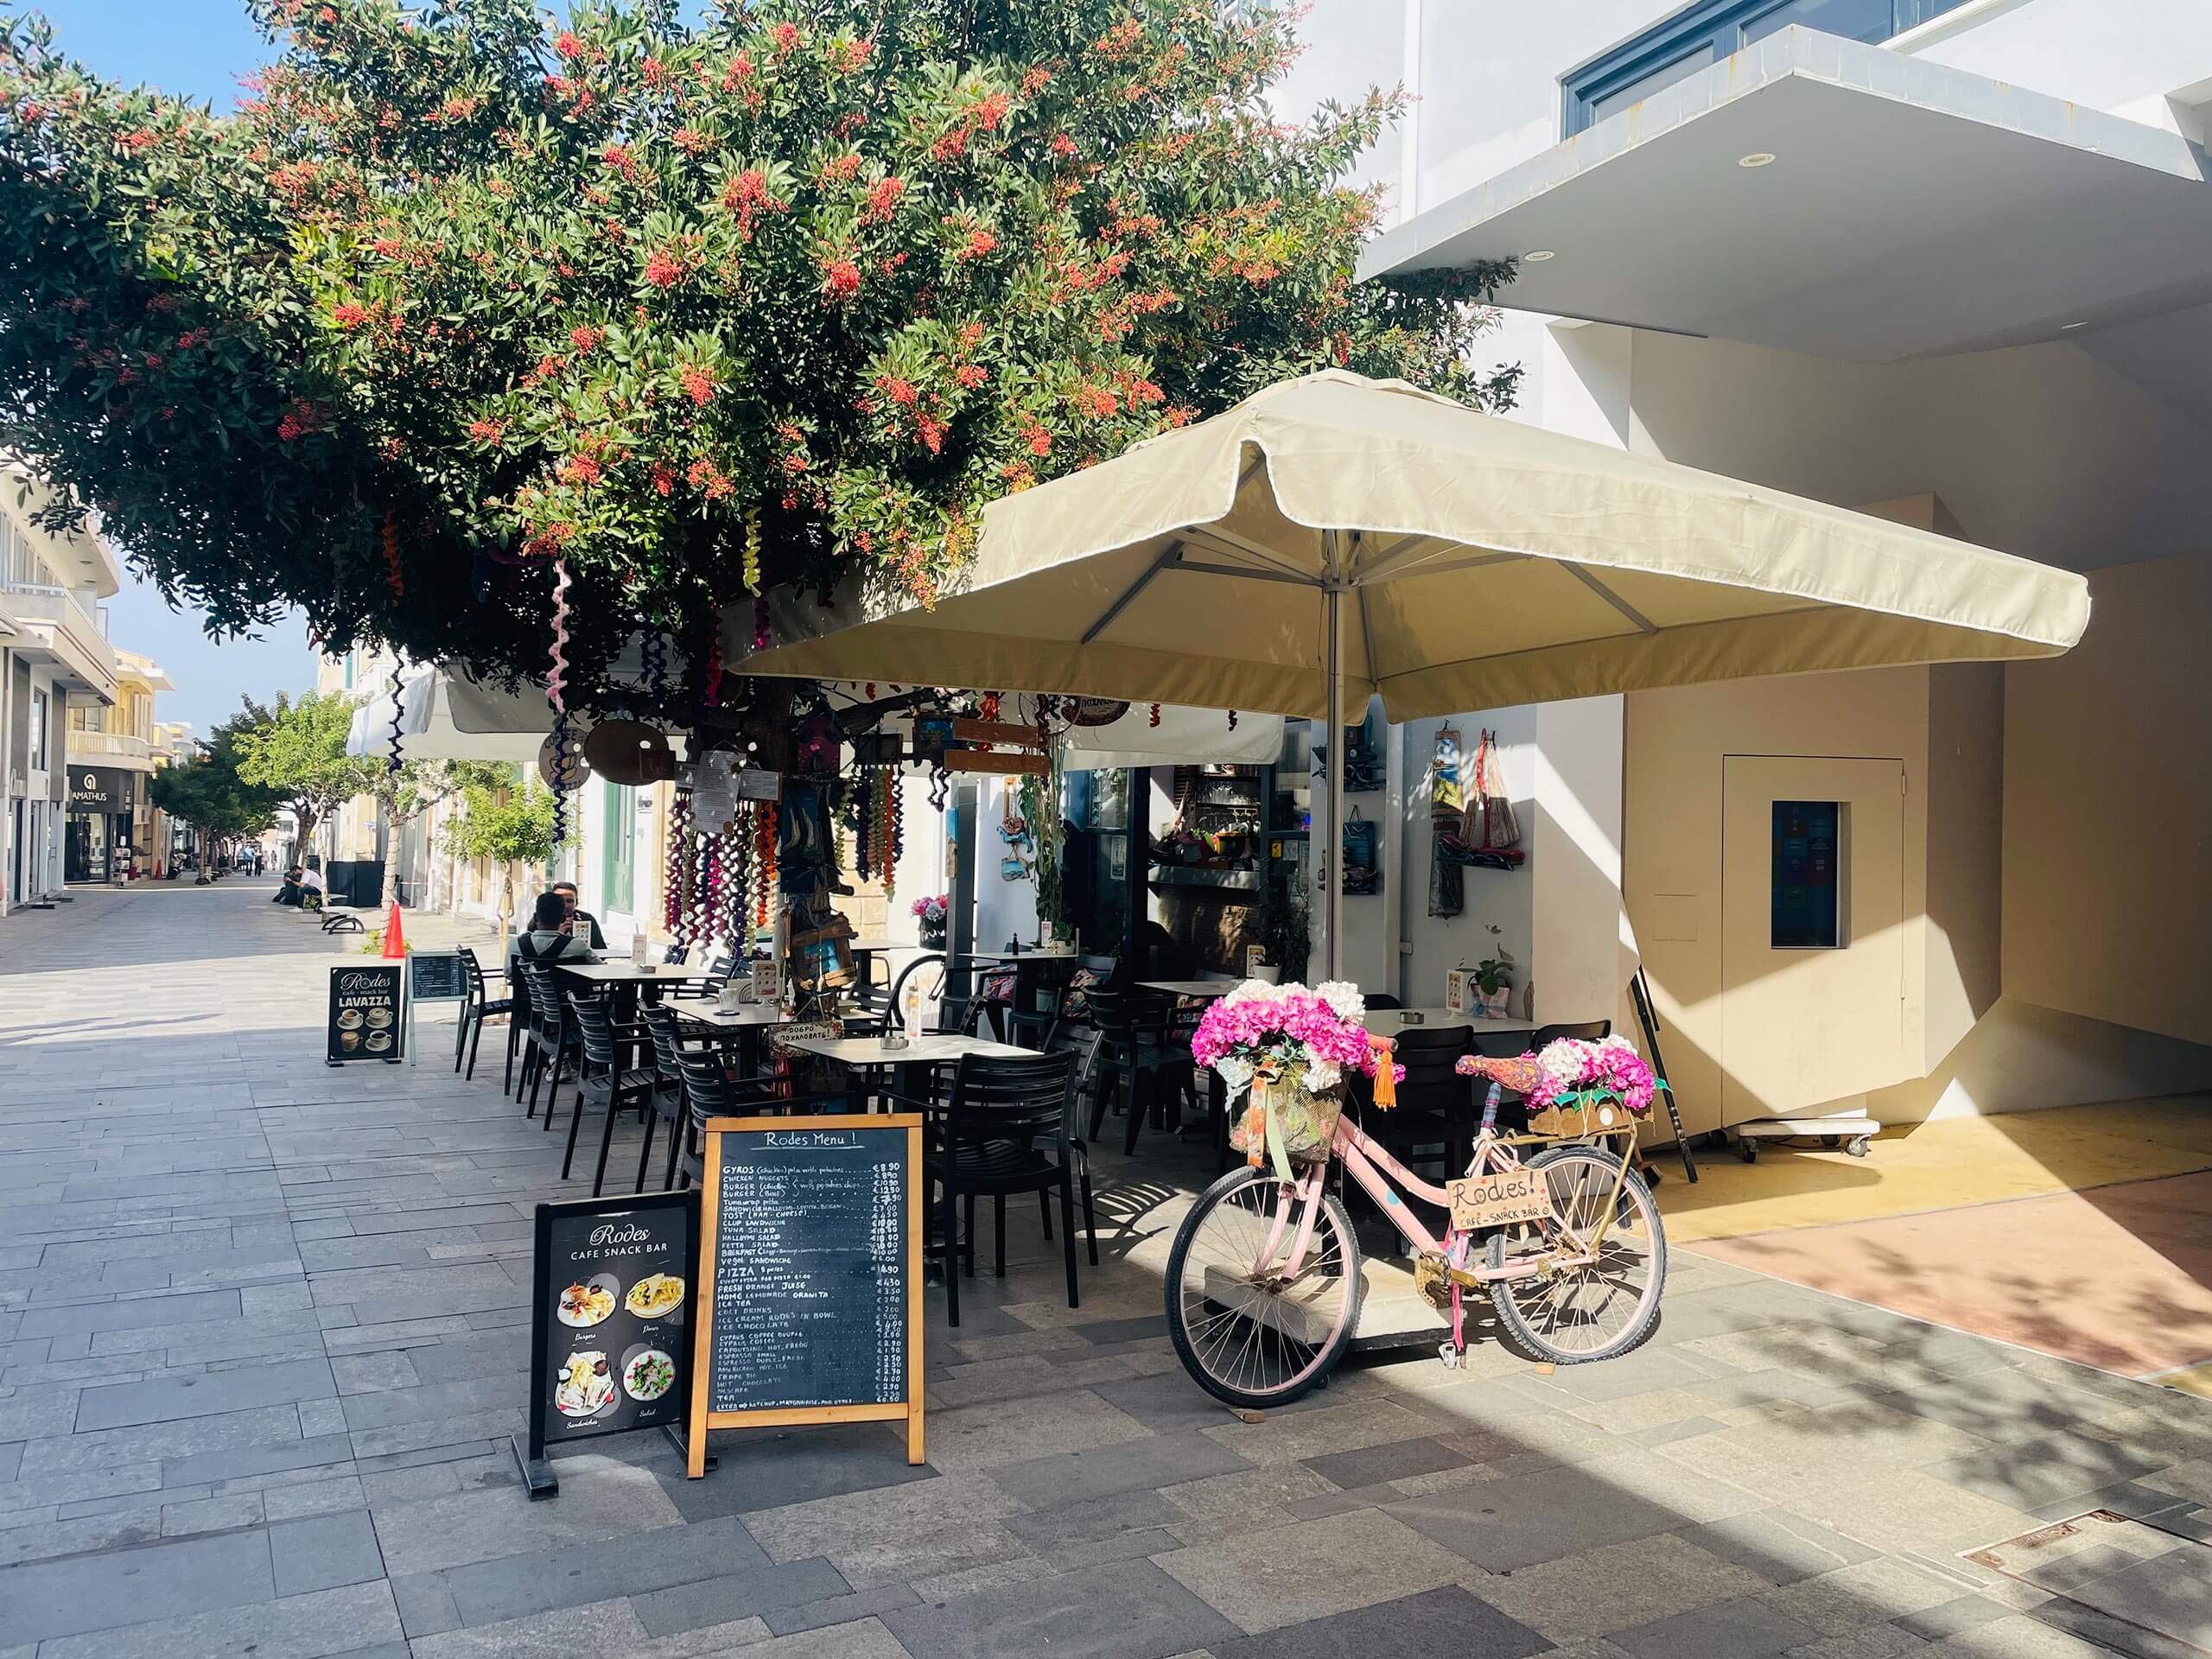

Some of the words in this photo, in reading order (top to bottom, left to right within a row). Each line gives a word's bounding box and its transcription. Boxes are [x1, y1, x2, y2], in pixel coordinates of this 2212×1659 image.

[72, 791, 107, 801] AMATHUS
[340, 972, 391, 990] Rodes
[338, 995, 391, 1007] LAVAZZA
[764, 1131, 808, 1146] Rodes
[812, 1133, 845, 1146] Menu
[722, 1166, 754, 1174] GYROS
[1452, 1171, 1535, 1210] Rodes!
[1522, 1207, 1539, 1217] BAR
[589, 1223, 651, 1246] Rodes
[570, 1249, 599, 1261] CAFE
[604, 1245, 641, 1257] SNACK
[646, 1243, 667, 1253] BAR
[718, 1266, 755, 1279] PIZZA
[718, 1284, 743, 1294] FRESH
